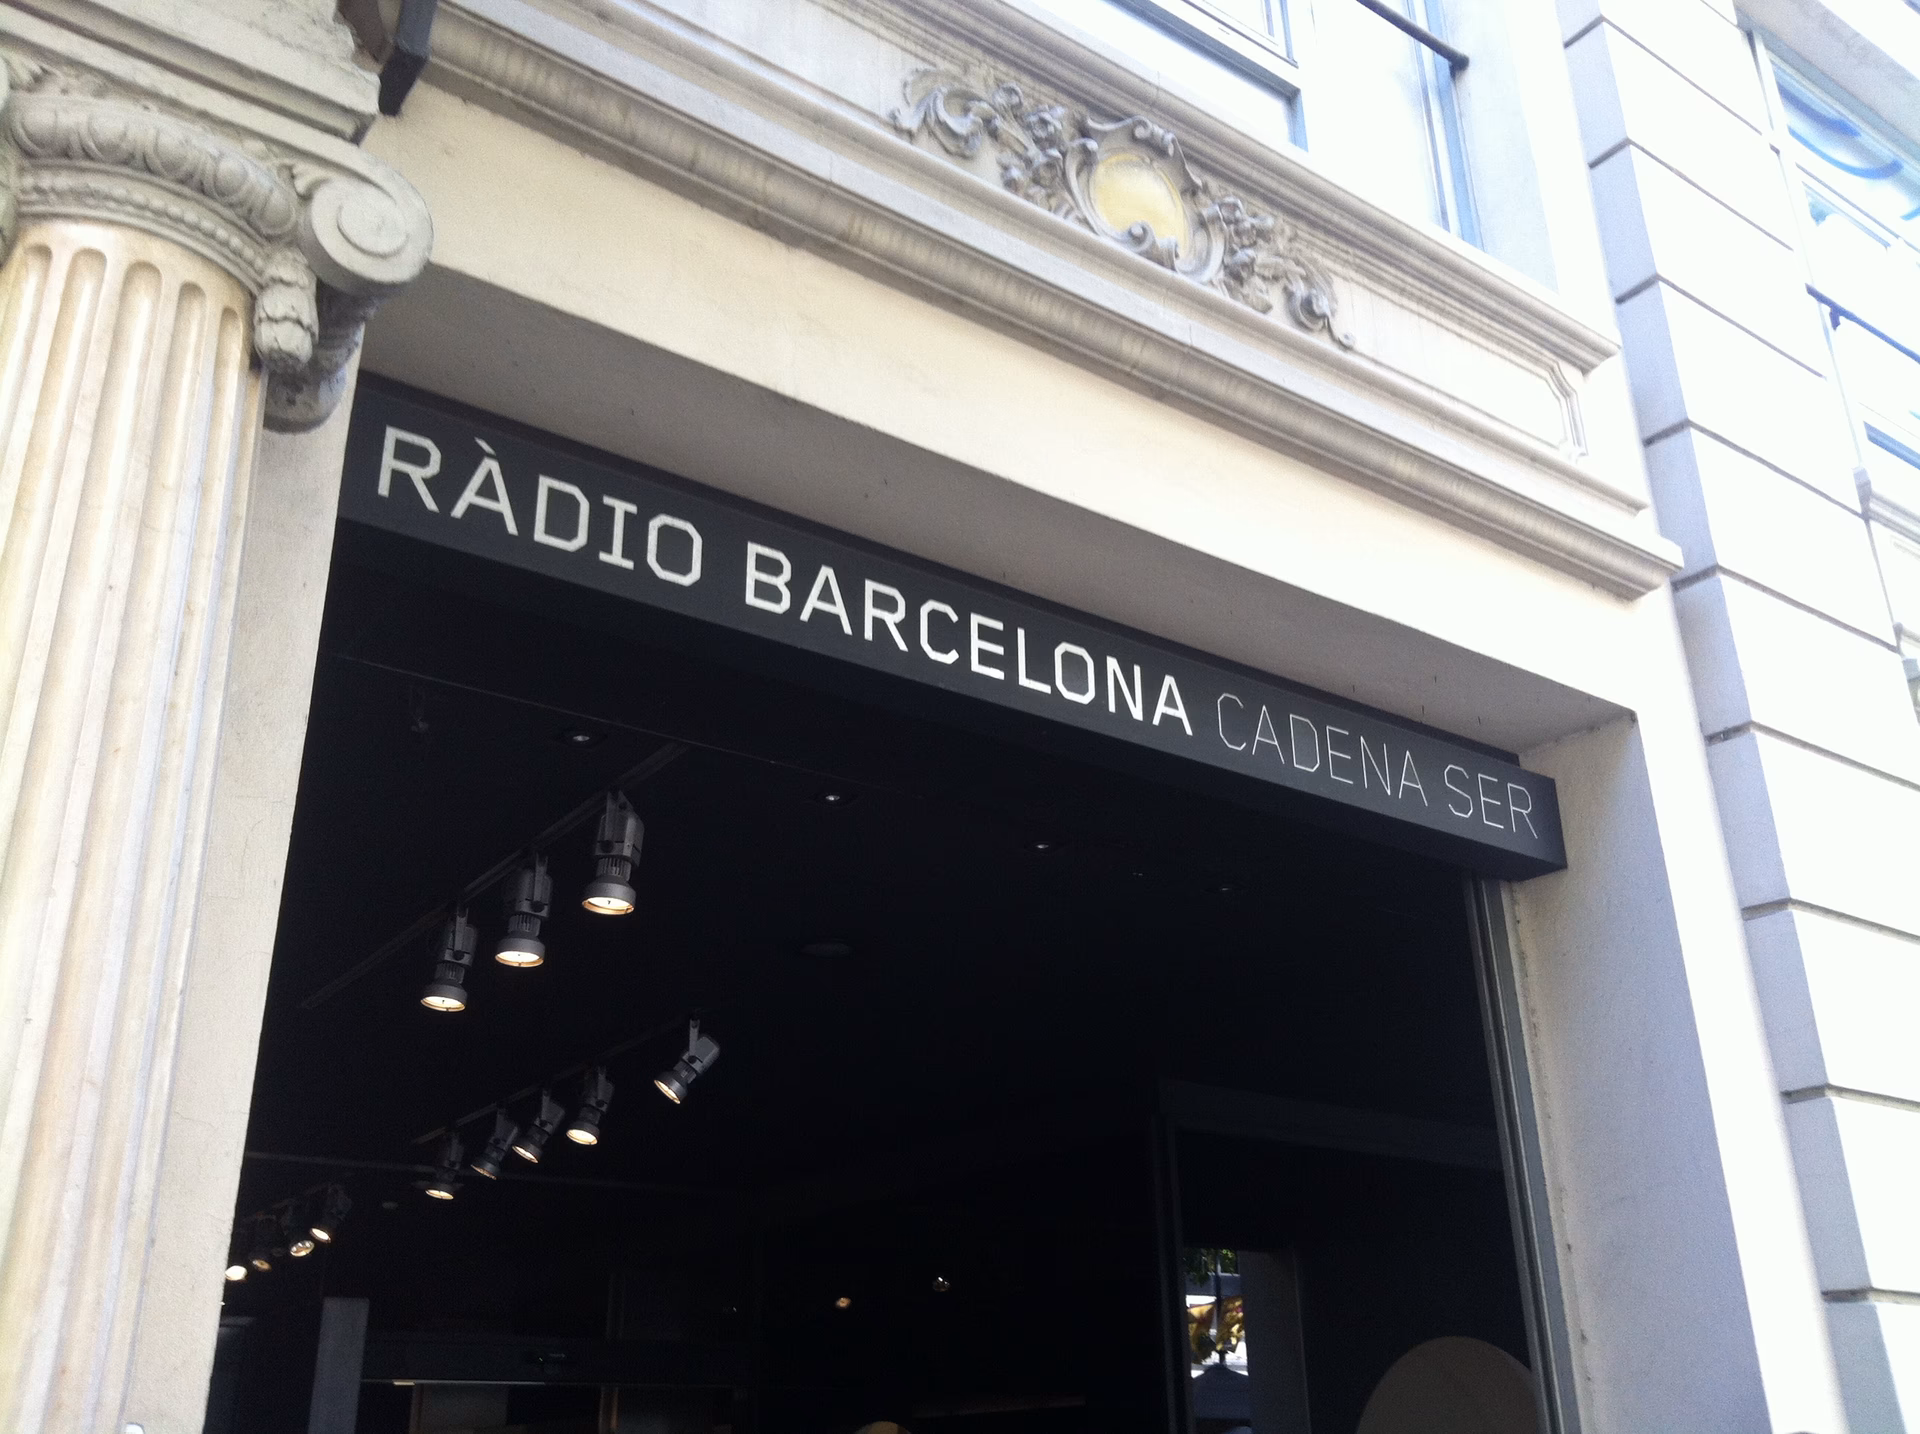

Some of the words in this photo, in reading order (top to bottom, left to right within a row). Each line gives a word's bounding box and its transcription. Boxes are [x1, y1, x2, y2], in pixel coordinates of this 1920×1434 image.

[377, 425, 703, 587] RÀDIO
[745, 541, 1193, 736] BARCELONA
[1217, 693, 1428, 806] CADENA
[1444, 764, 1538, 839] SER
